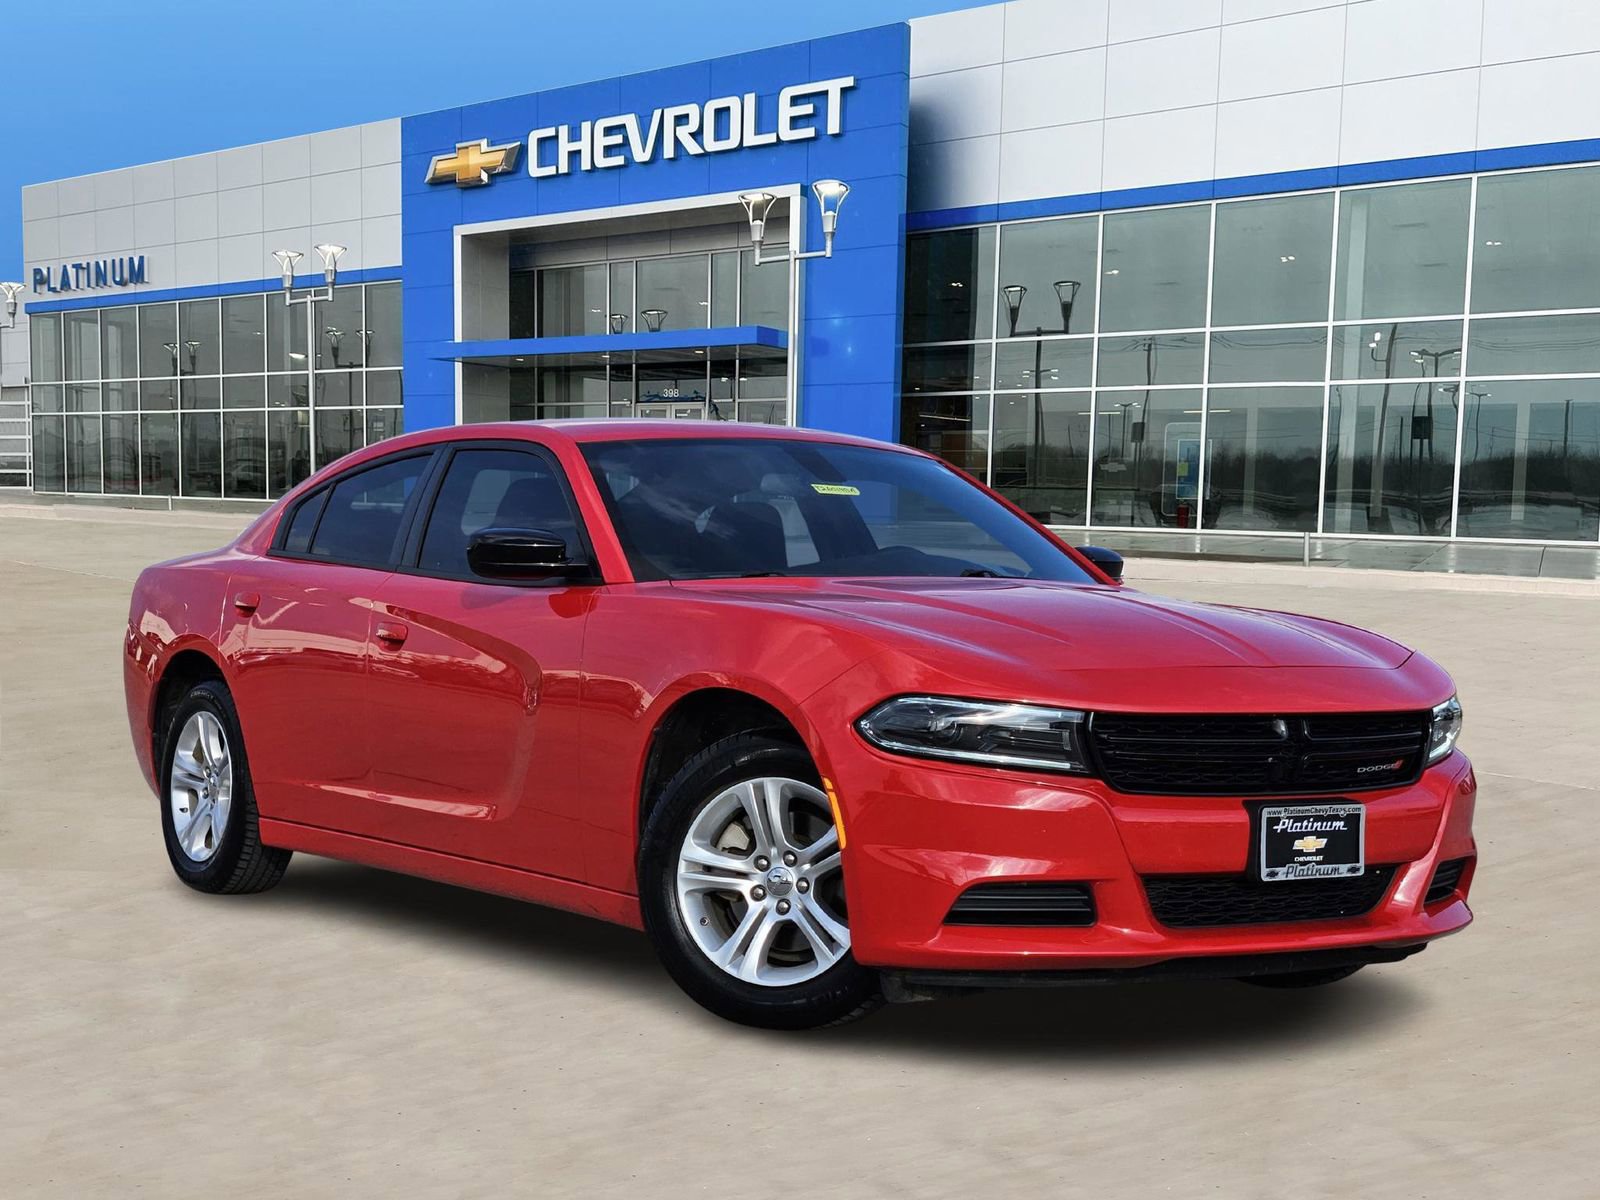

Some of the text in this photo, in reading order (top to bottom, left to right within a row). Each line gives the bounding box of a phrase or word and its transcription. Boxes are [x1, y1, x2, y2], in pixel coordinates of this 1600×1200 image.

[527, 75, 855, 178] CHEVROLET
[33, 256, 145, 293] PLATINUM
[663, 388, 679, 398] 398
[1357, 763, 1398, 773] DODGE
[1273, 818, 1347, 832] Platinum
[1283, 864, 1343, 878] Platinum
